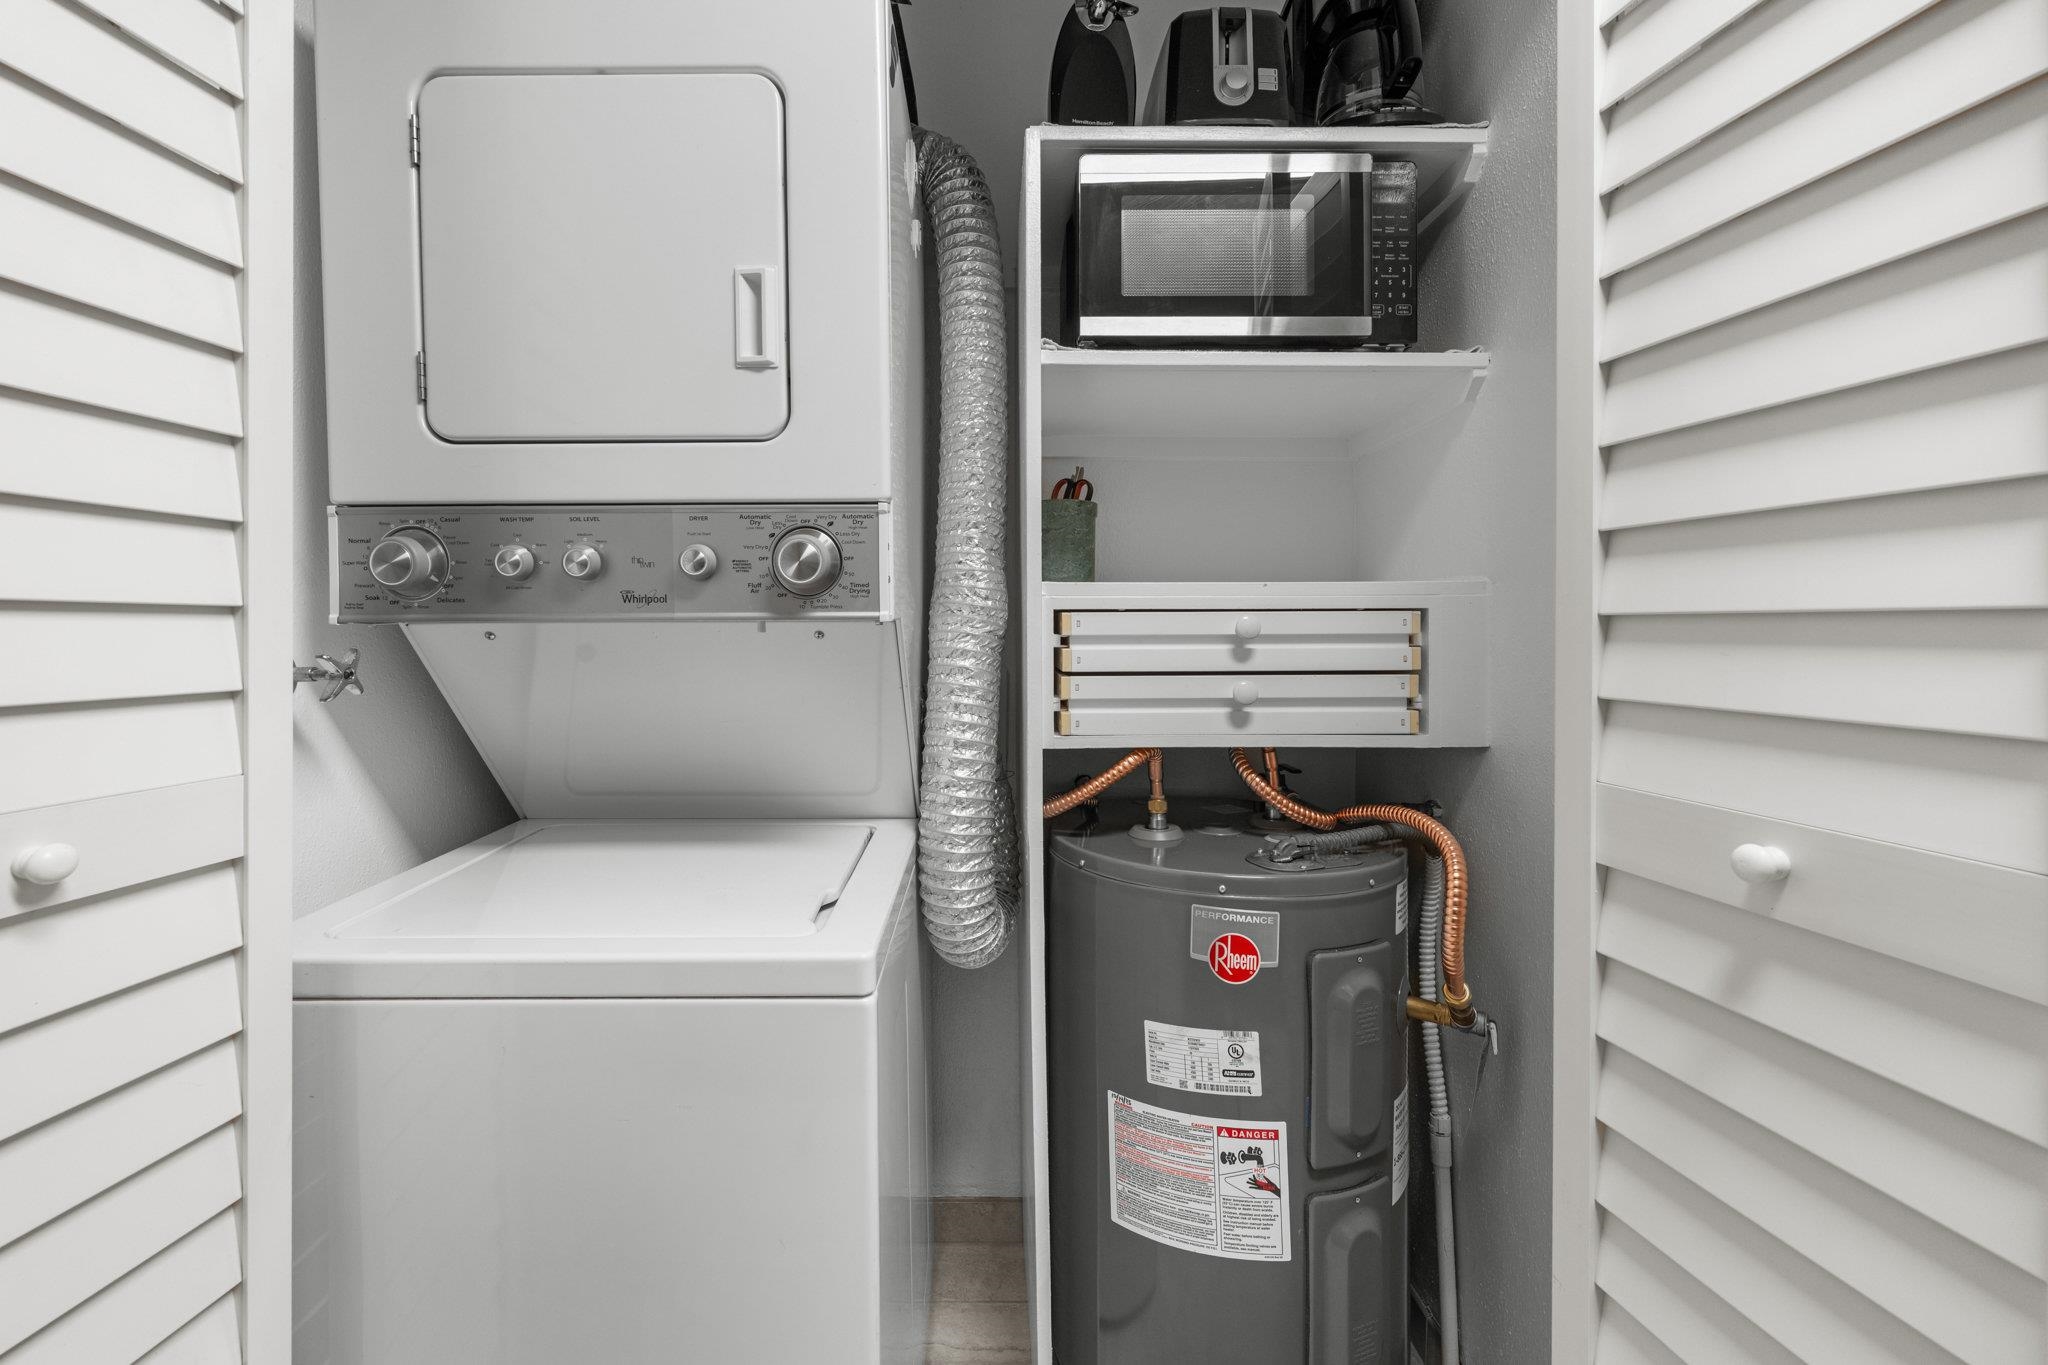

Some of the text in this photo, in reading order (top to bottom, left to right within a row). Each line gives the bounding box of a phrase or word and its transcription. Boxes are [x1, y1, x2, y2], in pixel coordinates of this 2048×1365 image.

[621, 594, 667, 606] Whirlpool
[1195, 910, 1274, 924] PERFORMANCE
[1215, 935, 1256, 976] Rheem
[1231, 1047, 1240, 1056] UL
[1232, 1130, 1274, 1138] DANGER
